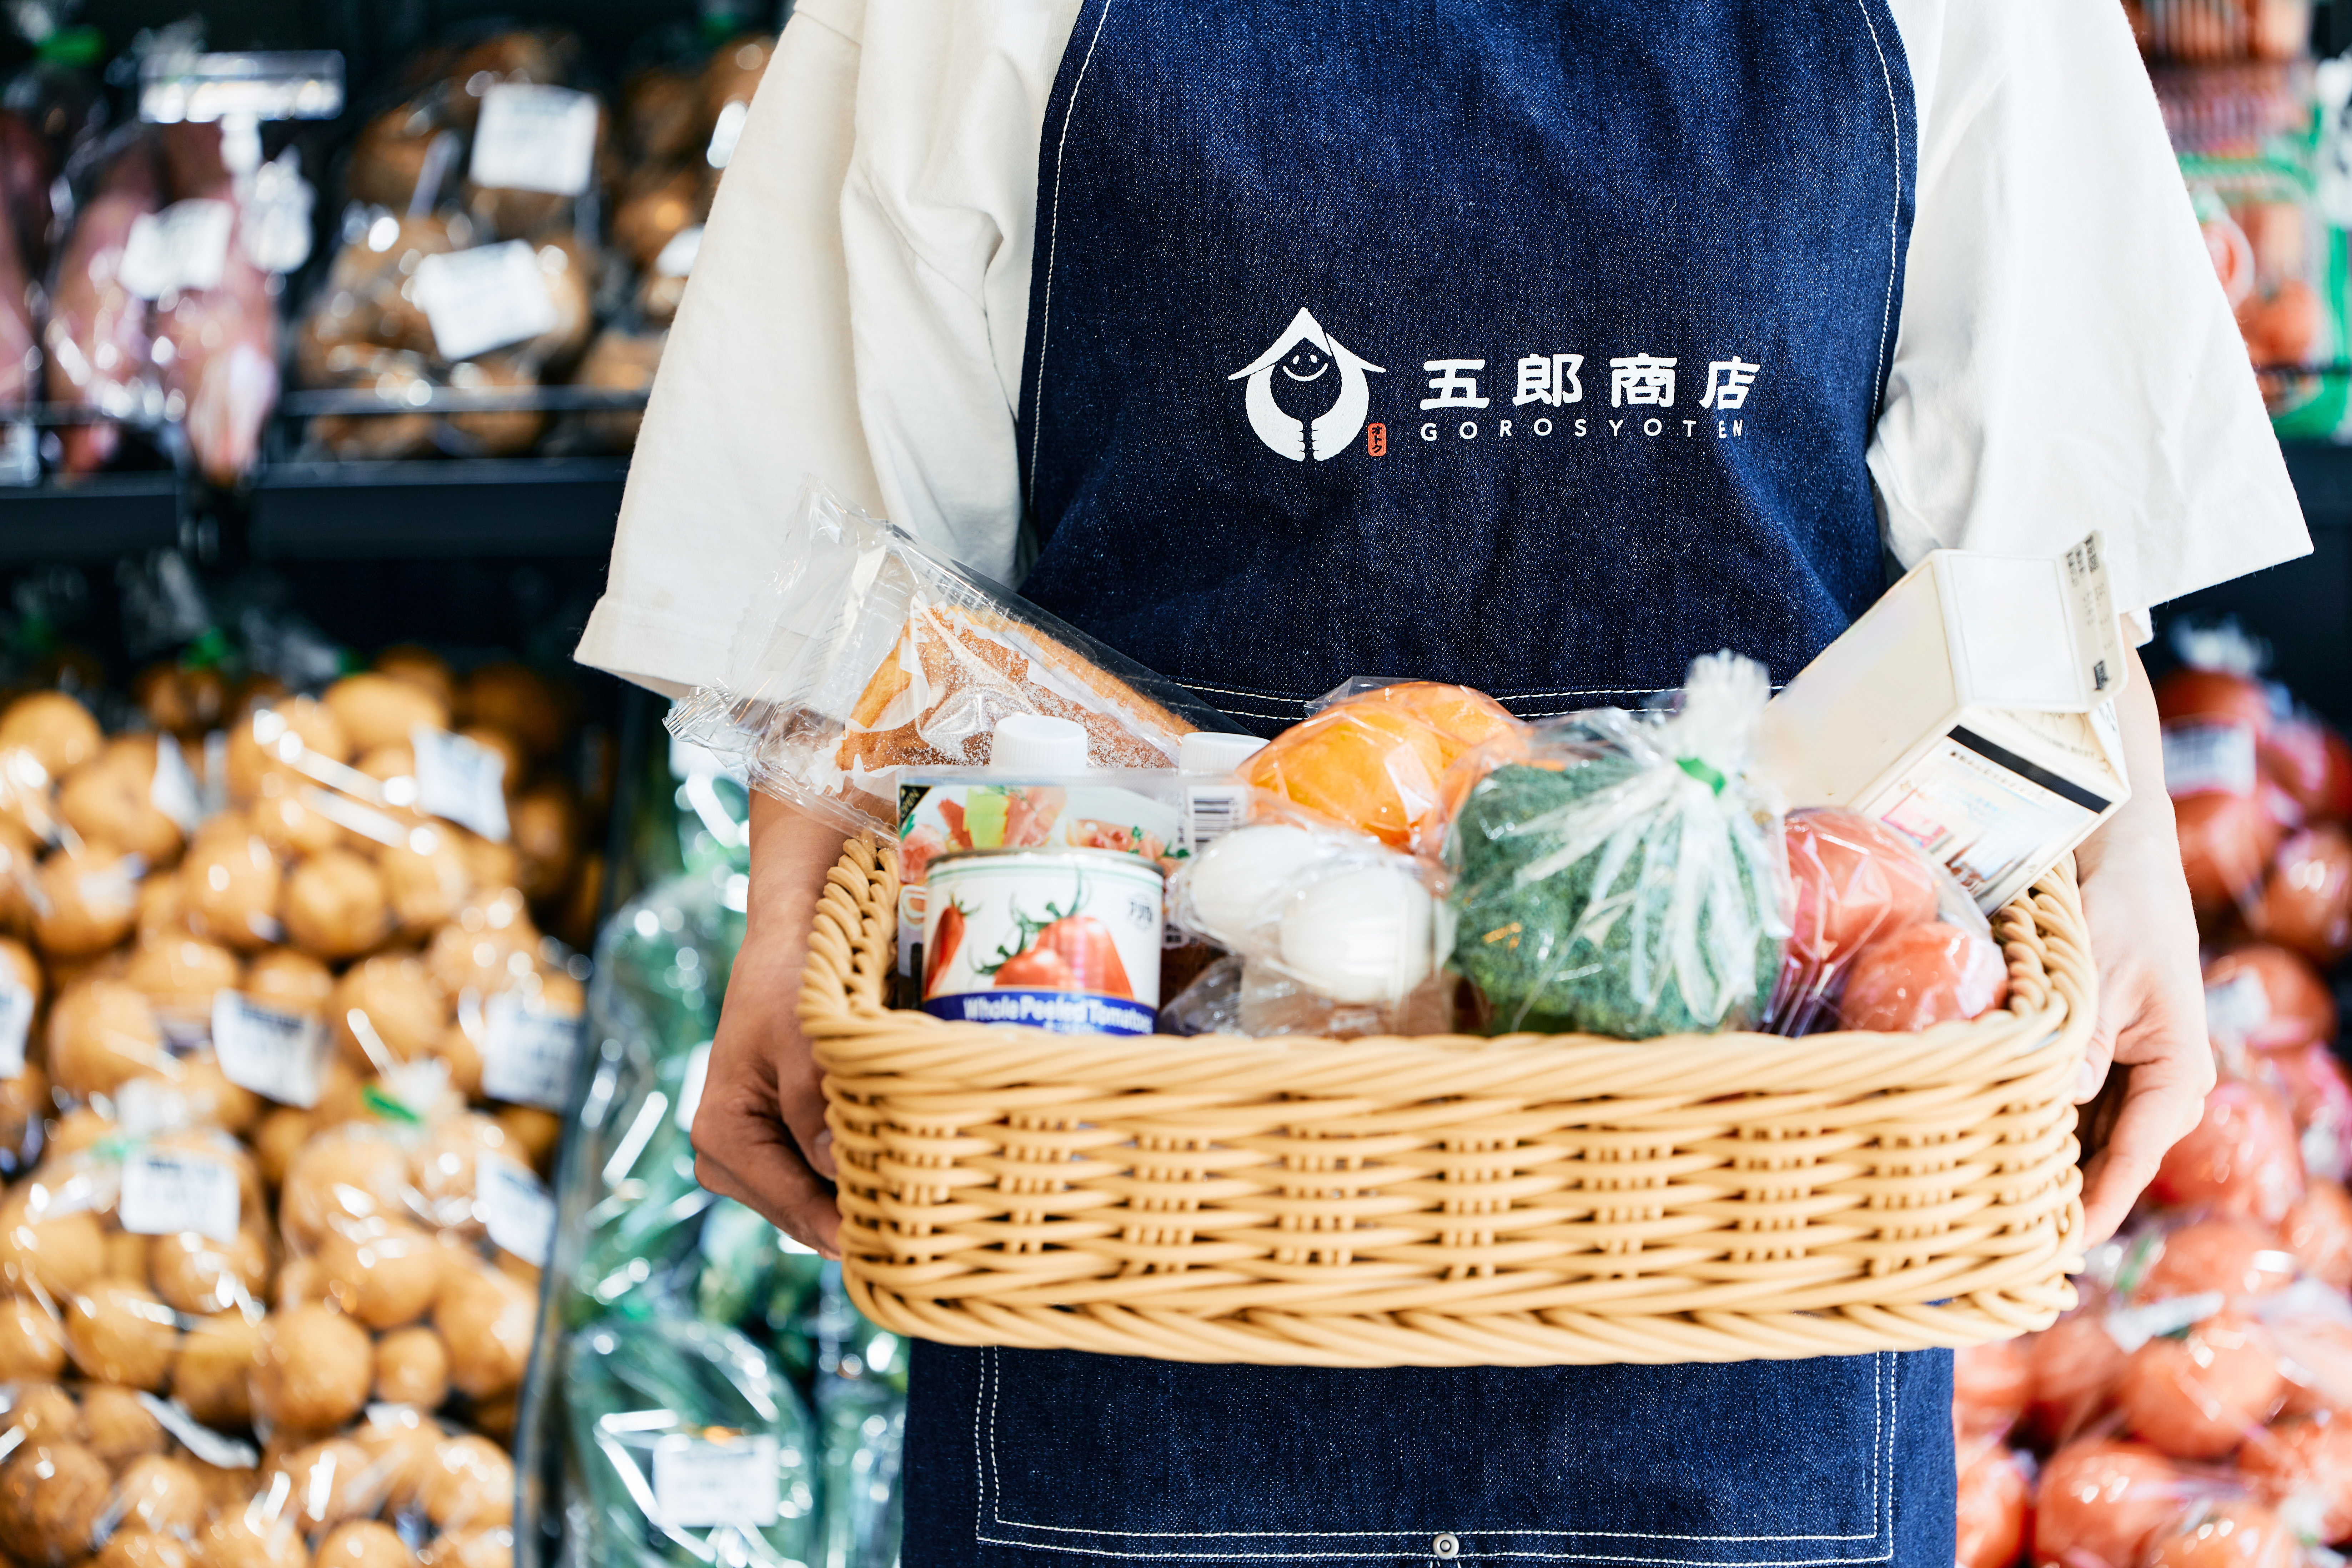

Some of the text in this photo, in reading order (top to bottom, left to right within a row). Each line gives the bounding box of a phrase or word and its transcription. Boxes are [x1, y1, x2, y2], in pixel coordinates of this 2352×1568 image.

[1419, 352, 1761, 411] 五郎商店
[1371, 425, 1382, 453] オトク
[1420, 418, 1743, 442] GOROSYOTEN
[964, 994, 1019, 1021] Whole
[1020, 994, 1088, 1024] Peeled
